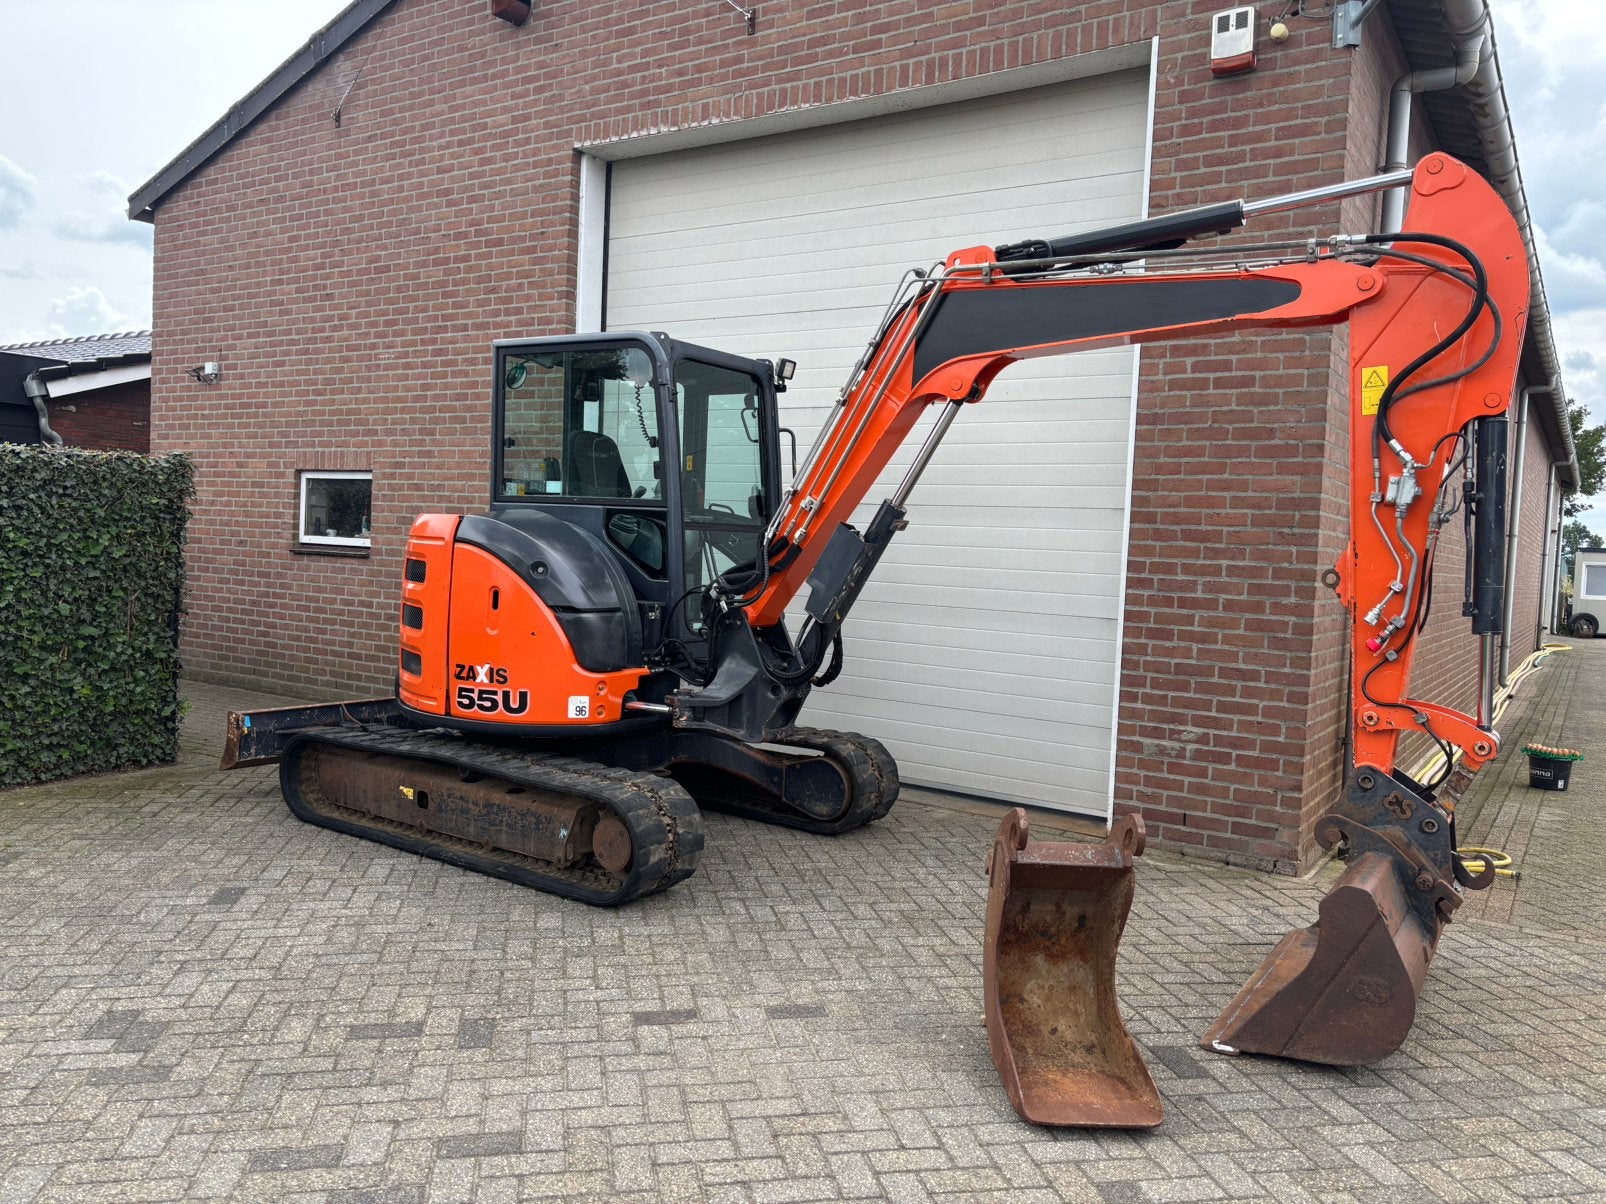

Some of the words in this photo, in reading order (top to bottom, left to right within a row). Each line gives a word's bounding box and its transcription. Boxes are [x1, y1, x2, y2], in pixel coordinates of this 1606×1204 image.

[454, 663, 508, 685] ZAXIS
[456, 685, 529, 716] 55U
[575, 705, 587, 717] 96
